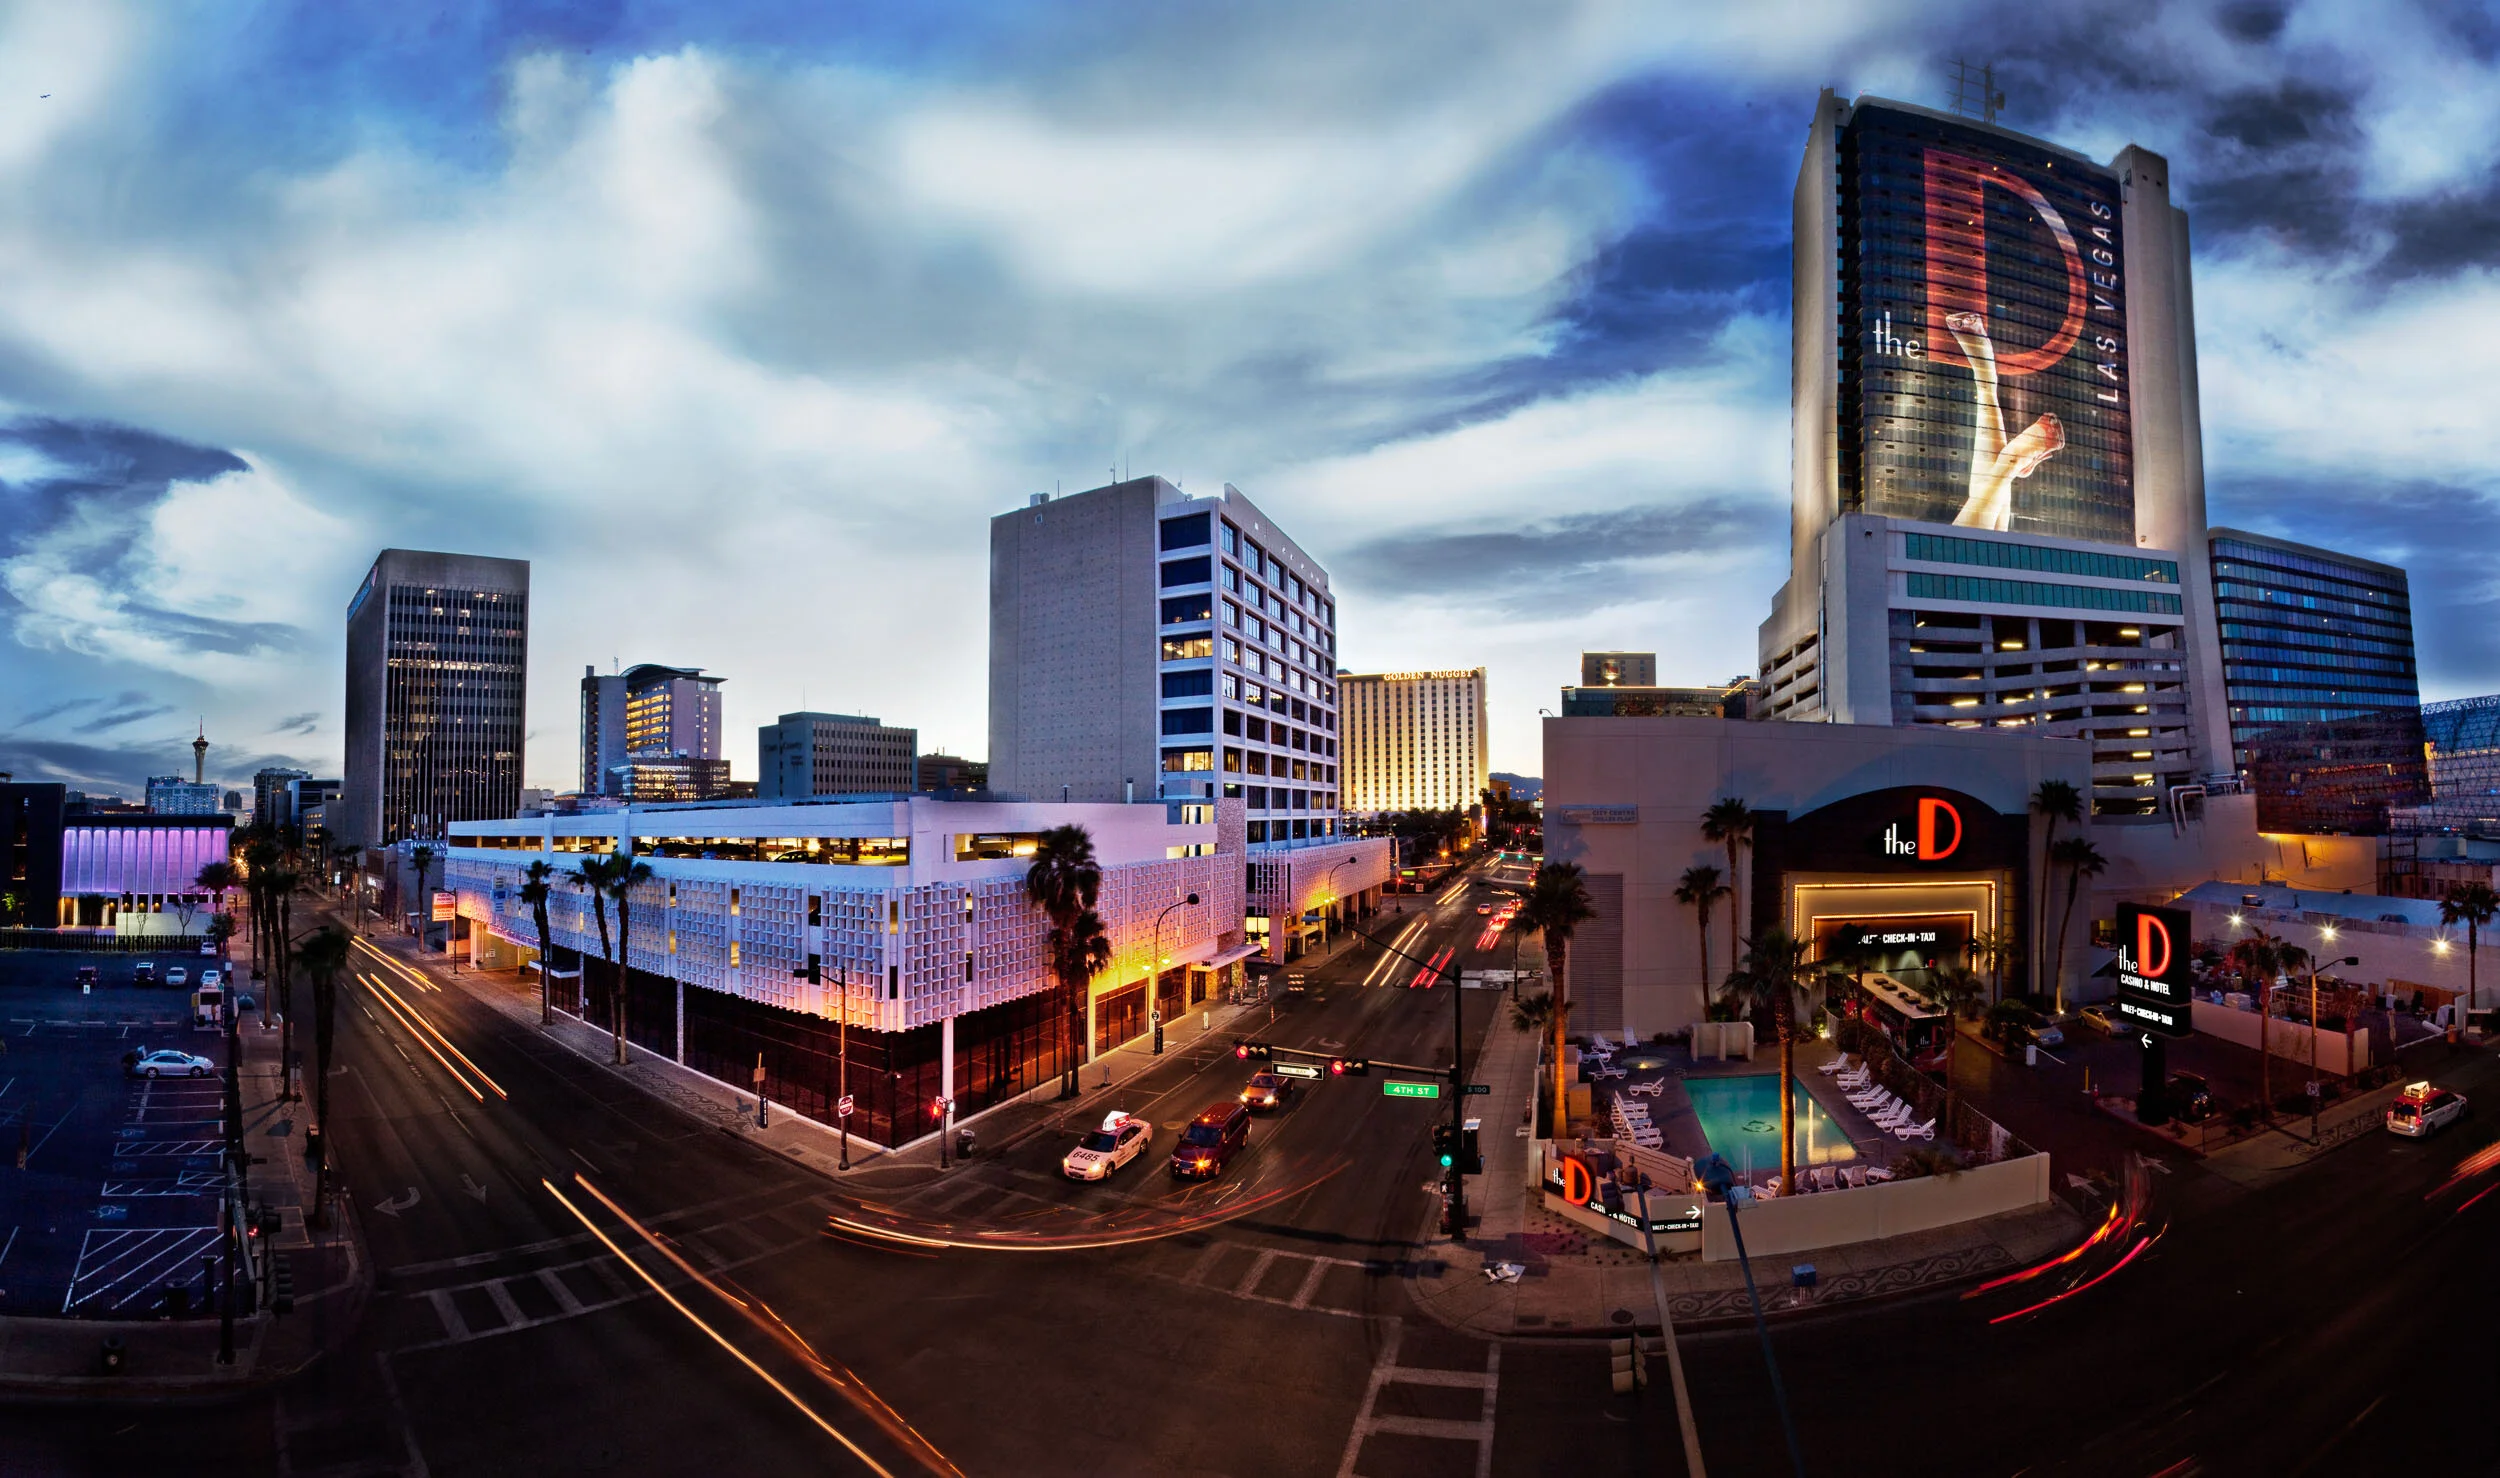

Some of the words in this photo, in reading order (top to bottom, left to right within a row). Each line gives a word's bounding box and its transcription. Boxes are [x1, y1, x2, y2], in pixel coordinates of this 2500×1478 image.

[1872, 311, 1921, 359] the
[1923, 148, 2087, 375] D
[2091, 201, 2117, 311] VEGAS
[2096, 336, 2118, 403] LAS
[1384, 672, 1424, 680] GOLDEN
[1431, 670, 1472, 679] NUGGET
[1884, 823, 1916, 855] the
[1918, 797, 1962, 861] D
[1883, 932, 1916, 943] CHECK-IN
[1920, 932, 1935, 942] TAXI
[2118, 944, 2138, 973] the
[2138, 913, 2171, 977] D
[2121, 974, 2143, 988] CASINO
[2144, 979, 2149, 990] &
[2150, 980, 2170, 995] HOTEL
[1393, 1086, 1414, 1095] 4TH
[1417, 1087, 1431, 1095] ST
[1073, 1151, 1100, 1162] 6485
[1552, 1168, 1566, 1188] the
[1564, 1155, 1591, 1206] D
[1619, 1213, 1638, 1227] HOTEL
